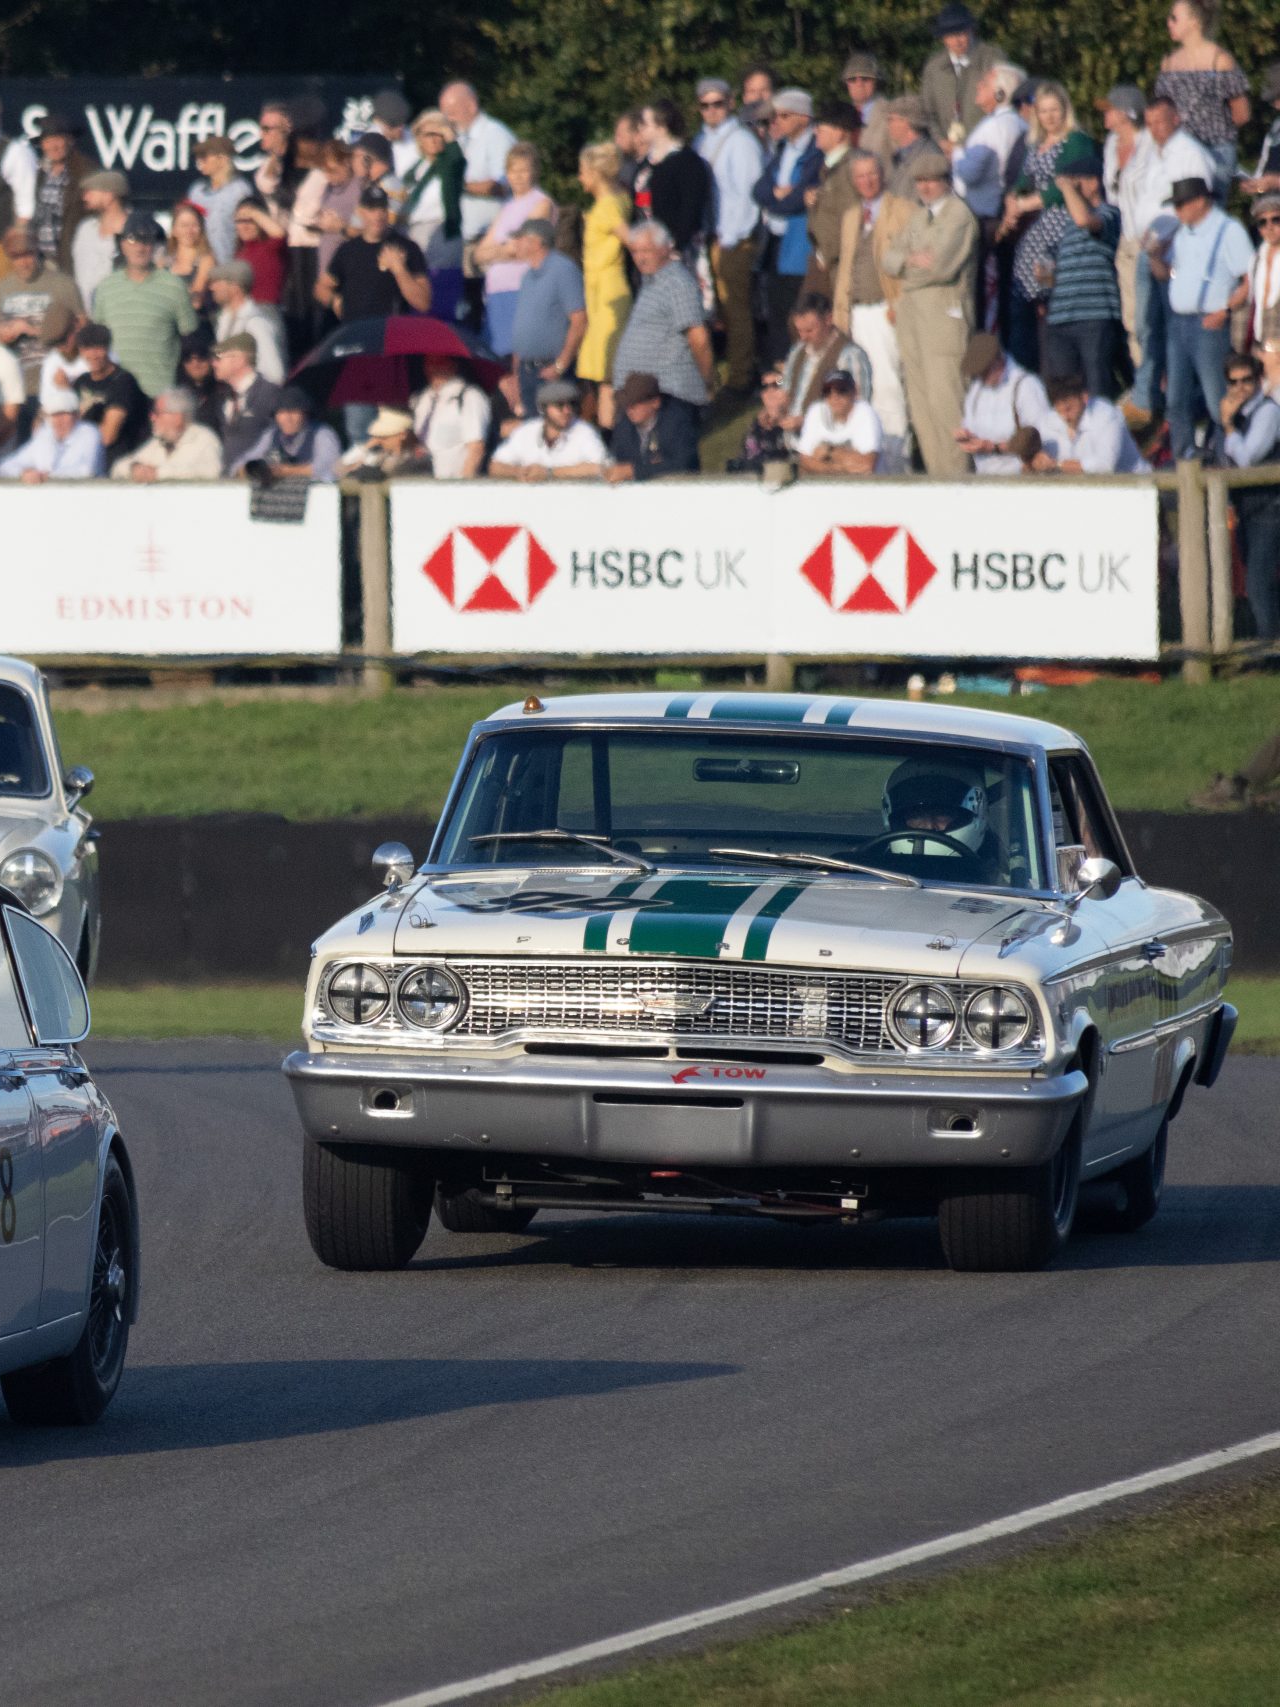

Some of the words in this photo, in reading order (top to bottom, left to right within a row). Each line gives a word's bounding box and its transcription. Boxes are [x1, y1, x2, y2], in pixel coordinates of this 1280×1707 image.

[570, 548, 684, 589] HSBC
[694, 550, 748, 589] UK
[950, 551, 1067, 593] HSBC
[1076, 552, 1132, 593] UK
[56, 595, 253, 620] EDMISTON
[707, 1066, 768, 1081] TOW
